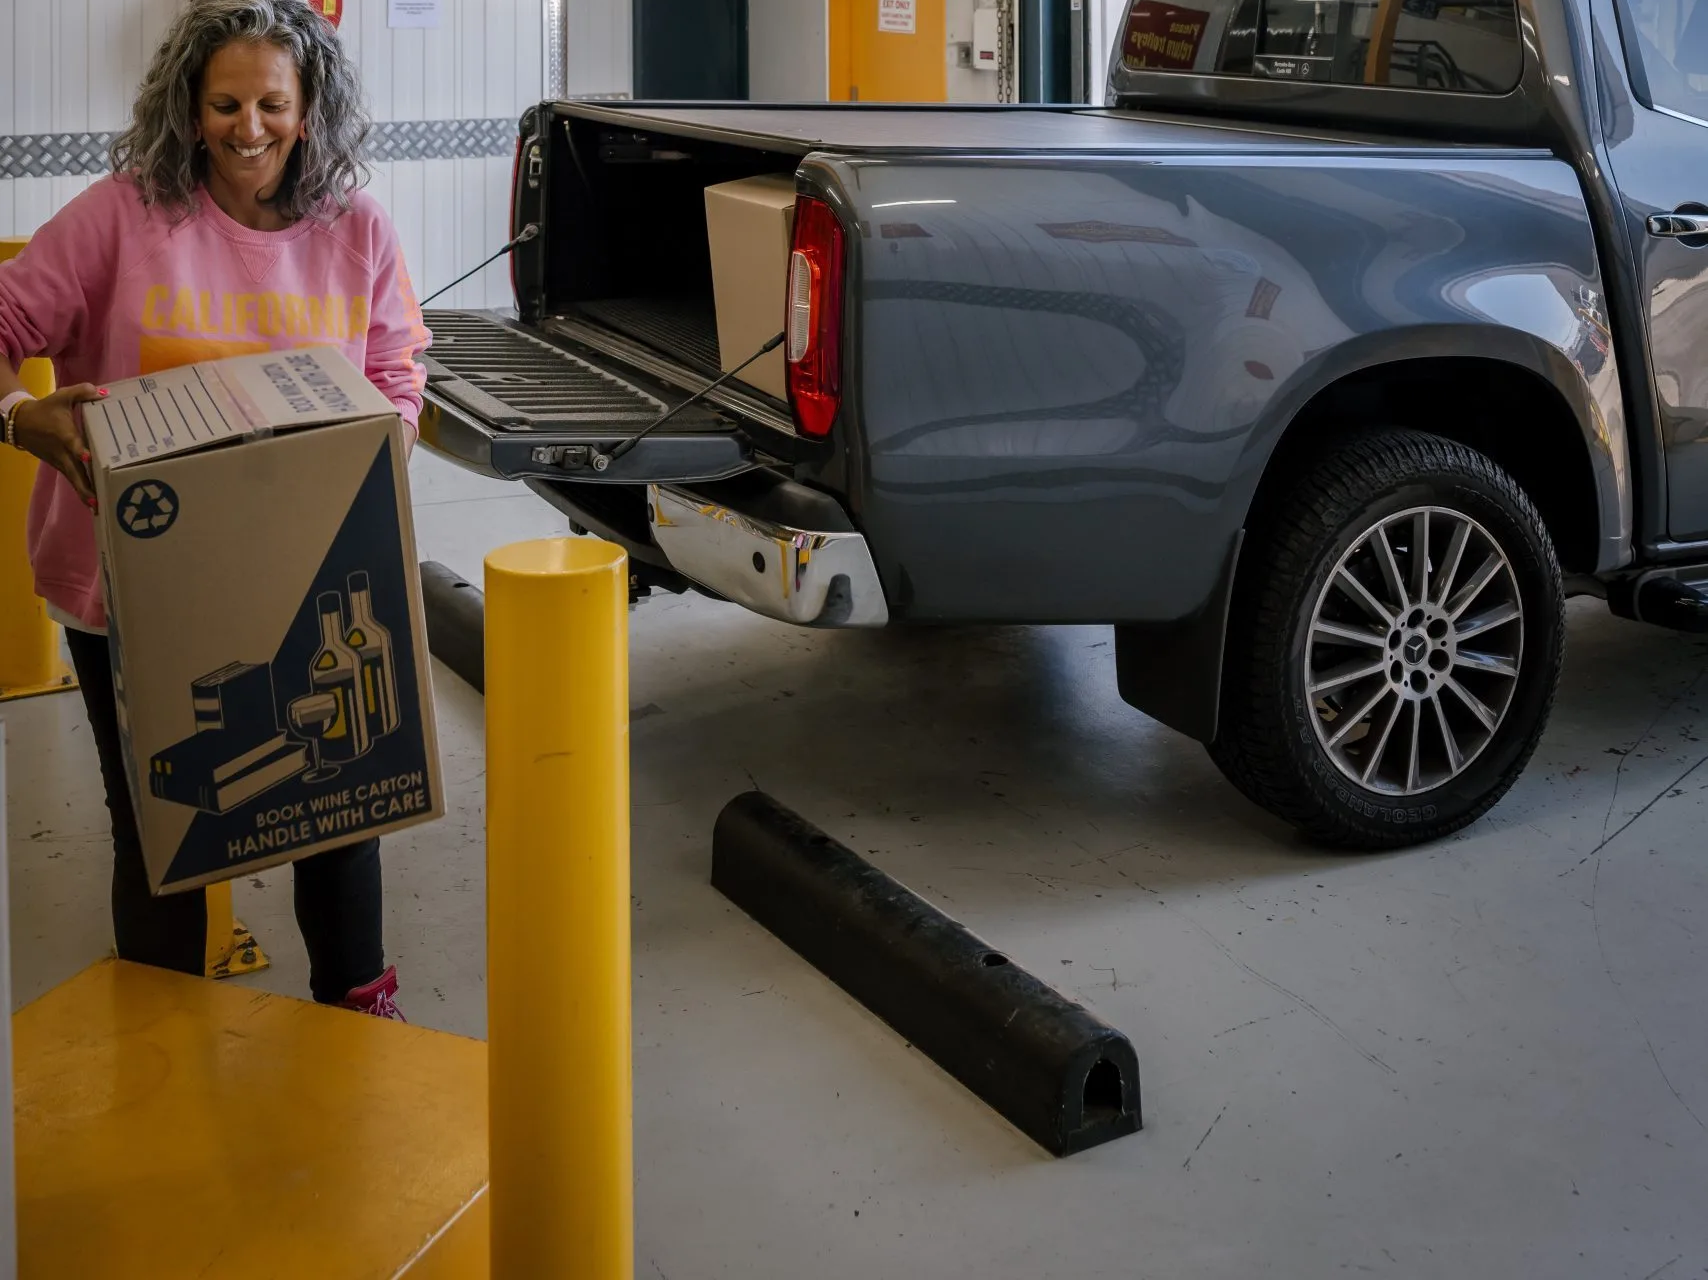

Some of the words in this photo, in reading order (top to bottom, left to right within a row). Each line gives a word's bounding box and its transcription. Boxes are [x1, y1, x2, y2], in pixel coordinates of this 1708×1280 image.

[141, 284, 369, 342] CALIFORNIA
[227, 820, 311, 859] HANDLE
[316, 806, 364, 835] WITH
[370, 789, 425, 819] CARE
[255, 803, 306, 829] BOOK
[309, 790, 351, 813] WINE
[355, 771, 423, 801] CARTON
